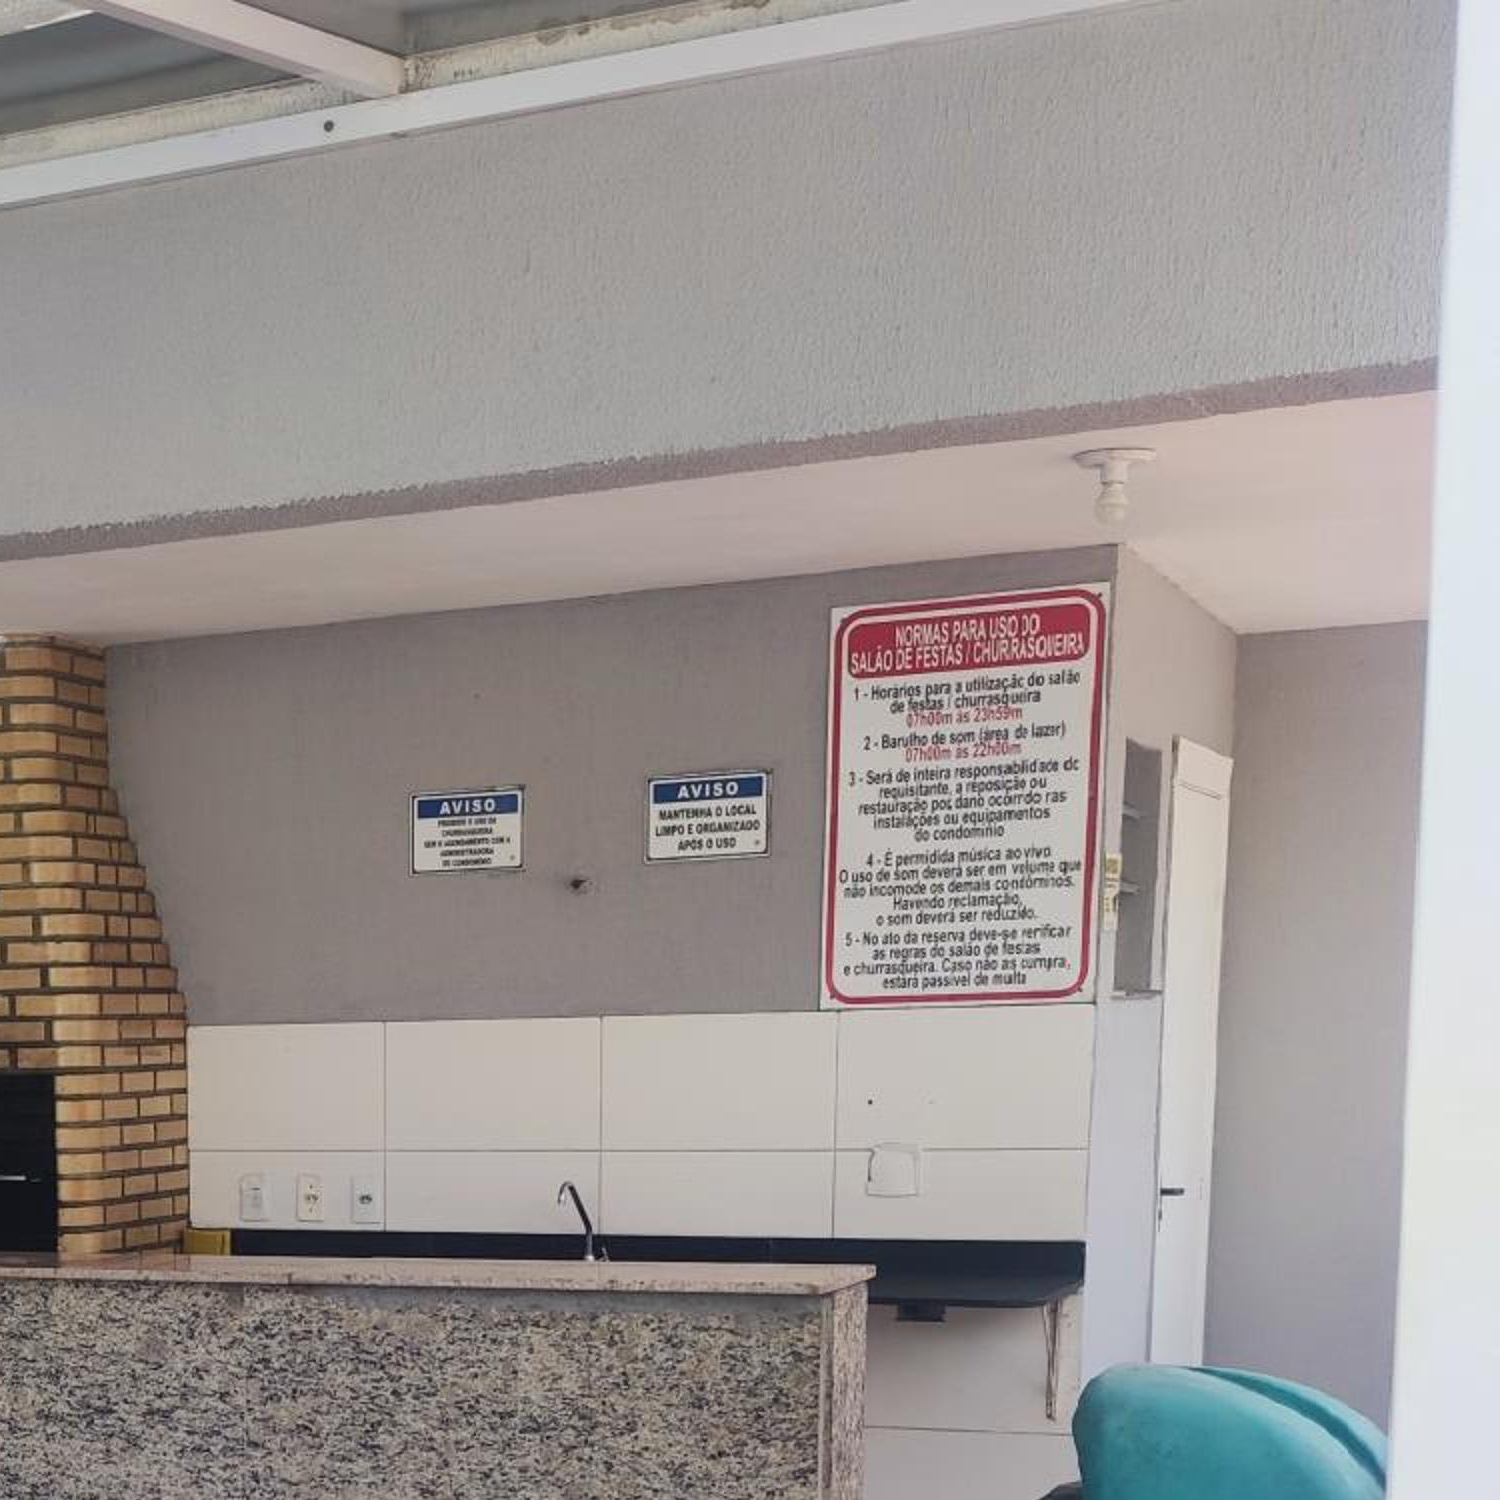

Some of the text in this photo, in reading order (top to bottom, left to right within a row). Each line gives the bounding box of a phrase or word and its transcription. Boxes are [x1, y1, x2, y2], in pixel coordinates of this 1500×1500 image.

[895, 612, 1041, 648] NORMAS PARA USO DO
[851, 645, 894, 674] SALÃO
[895, 647, 913, 671] DE
[915, 643, 963, 668] FESTAS
[973, 632, 1084, 663] CHURRASQUEIRA
[855, 687, 859, 701] 1
[871, 683, 921, 700] Horários
[925, 682, 951, 701] para
[955, 682, 962, 694] a
[966, 673, 1024, 693] utilização
[1027, 672, 1045, 687] do
[1049, 669, 1080, 685] salão
[890, 699, 905, 715] de
[907, 697, 944, 713] festas
[954, 688, 1041, 709] churrasqueira
[863, 735, 871, 751] 2
[881, 731, 928, 750] Barulho
[931, 731, 946, 745] de
[949, 731, 975, 745] som
[1015, 723, 1028, 739] de
[849, 771, 856, 786] 3
[866, 768, 892, 785] Será
[896, 768, 910, 783] de
[913, 766, 951, 781] inteira
[954, 759, 1059, 780] responsabilidade
[678, 781, 739, 799] AVISO
[956, 782, 963, 794] a
[966, 775, 1027, 796] reposição
[1029, 777, 1047, 789] ou
[440, 798, 496, 815] AVISO
[660, 803, 756, 820] MANTENHA O LOCAL
[858, 799, 927, 816] restauração
[956, 793, 985, 809] dano
[988, 790, 1042, 807] ocorrido
[873, 806, 1050, 829] instalações ou equipamentos
[656, 820, 760, 837] LIMPO E ORGANIZADO
[914, 828, 930, 842] do
[706, 838, 713, 849] O
[716, 837, 736, 849] USO
[866, 852, 873, 867] 4
[958, 847, 1000, 861] música
[1006, 848, 1022, 860] ao
[840, 869, 848, 883] O
[852, 871, 873, 882] uso
[876, 868, 890, 882] de
[894, 867, 918, 881] som
[966, 865, 985, 876] ser
[988, 864, 1006, 876] em
[1012, 859, 1054, 874] volume
[1059, 860, 1081, 876] que
[869, 880, 926, 896] incomode
[930, 882, 944, 894] os
[948, 878, 990, 892] demais
[894, 895, 945, 910] Havendo
[876, 915, 884, 926] o
[887, 912, 912, 925] som
[960, 911, 977, 922] ser
[845, 932, 852, 946] 5
[863, 931, 878, 945] No
[882, 931, 900, 944] ato
[903, 930, 918, 944] da
[922, 929, 965, 943] reserva
[969, 926, 1017, 941] deve-se
[1022, 923, 1071, 938] verificar
[872, 949, 885, 960] as
[890, 947, 926, 963] regras
[949, 941, 980, 957] salão
[984, 940, 998, 956] de
[1002, 940, 1040, 955] festas
[844, 965, 851, 976] e
[942, 957, 972, 972] Caso
[976, 957, 997, 971] não
[1001, 958, 1017, 970] as
[974, 972, 988, 986] de
[992, 970, 1027, 984] multa
